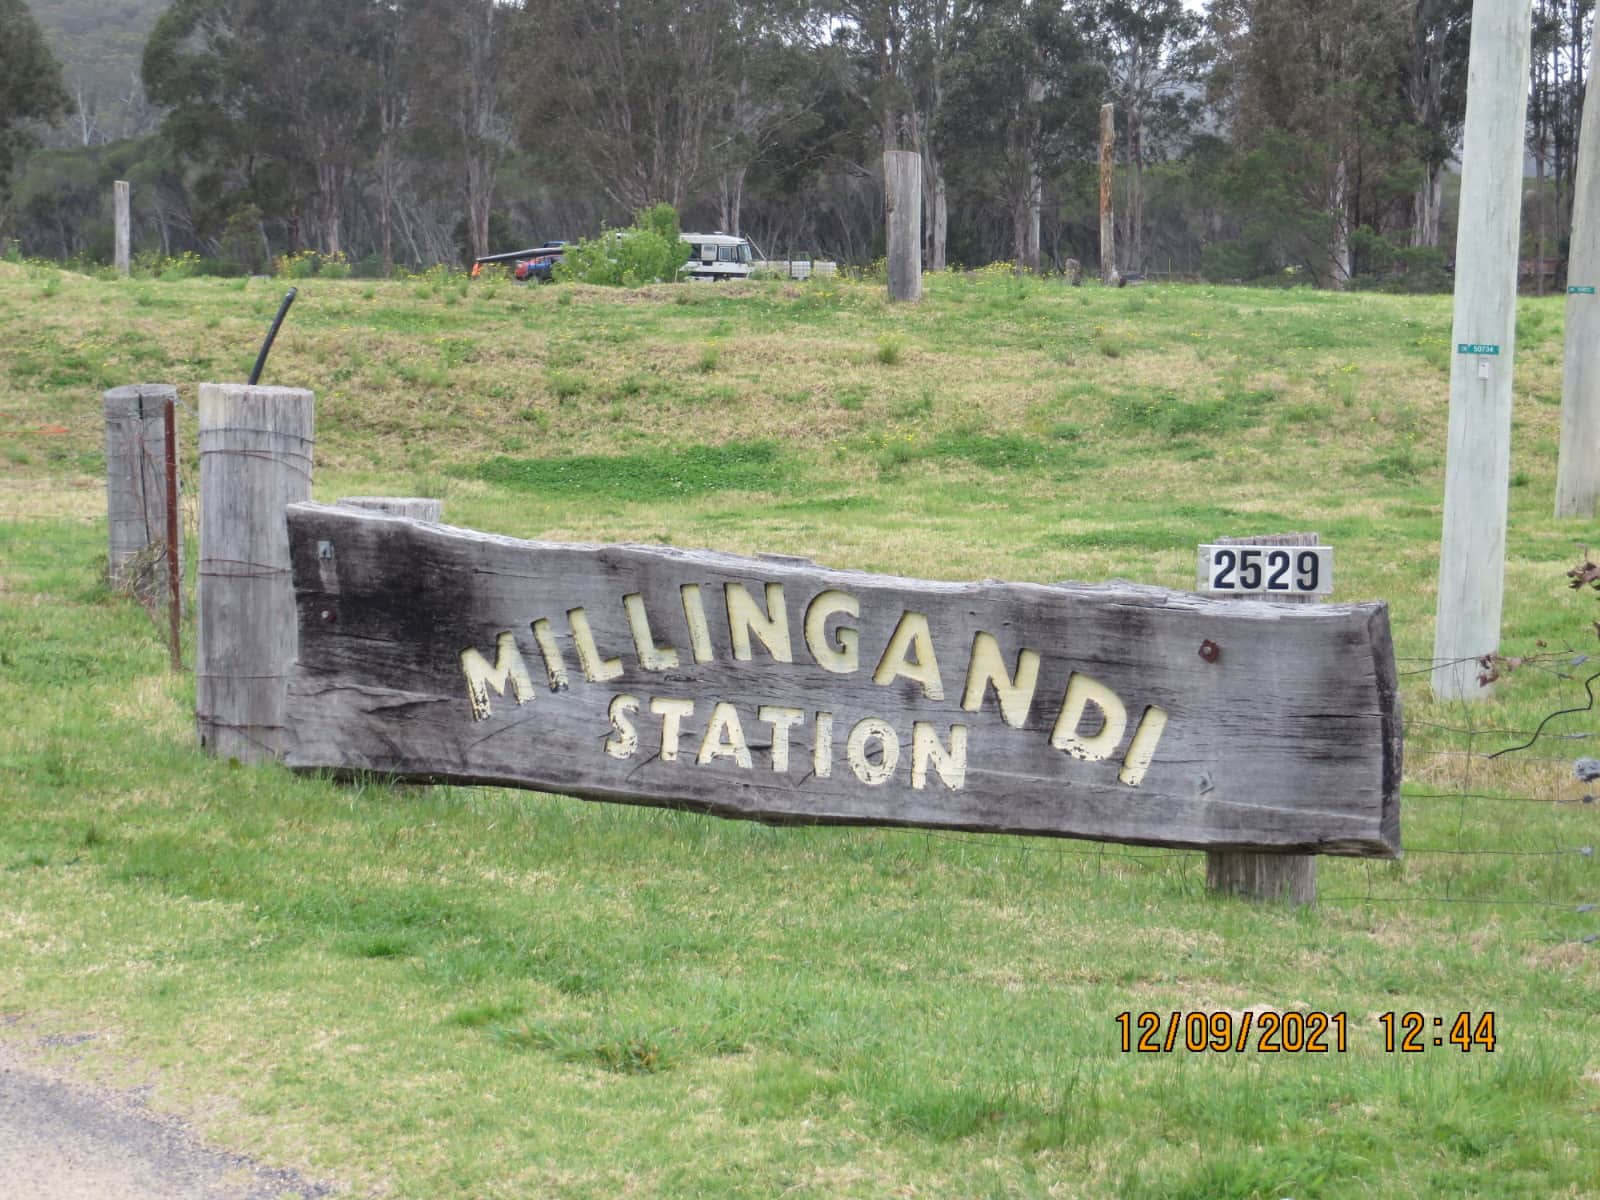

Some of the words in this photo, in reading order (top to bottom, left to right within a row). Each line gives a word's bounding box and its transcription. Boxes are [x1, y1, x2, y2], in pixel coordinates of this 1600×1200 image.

[1213, 549, 1319, 591] 2529
[459, 582, 1169, 787] MILLINGANDI
[605, 694, 968, 791] STATION
